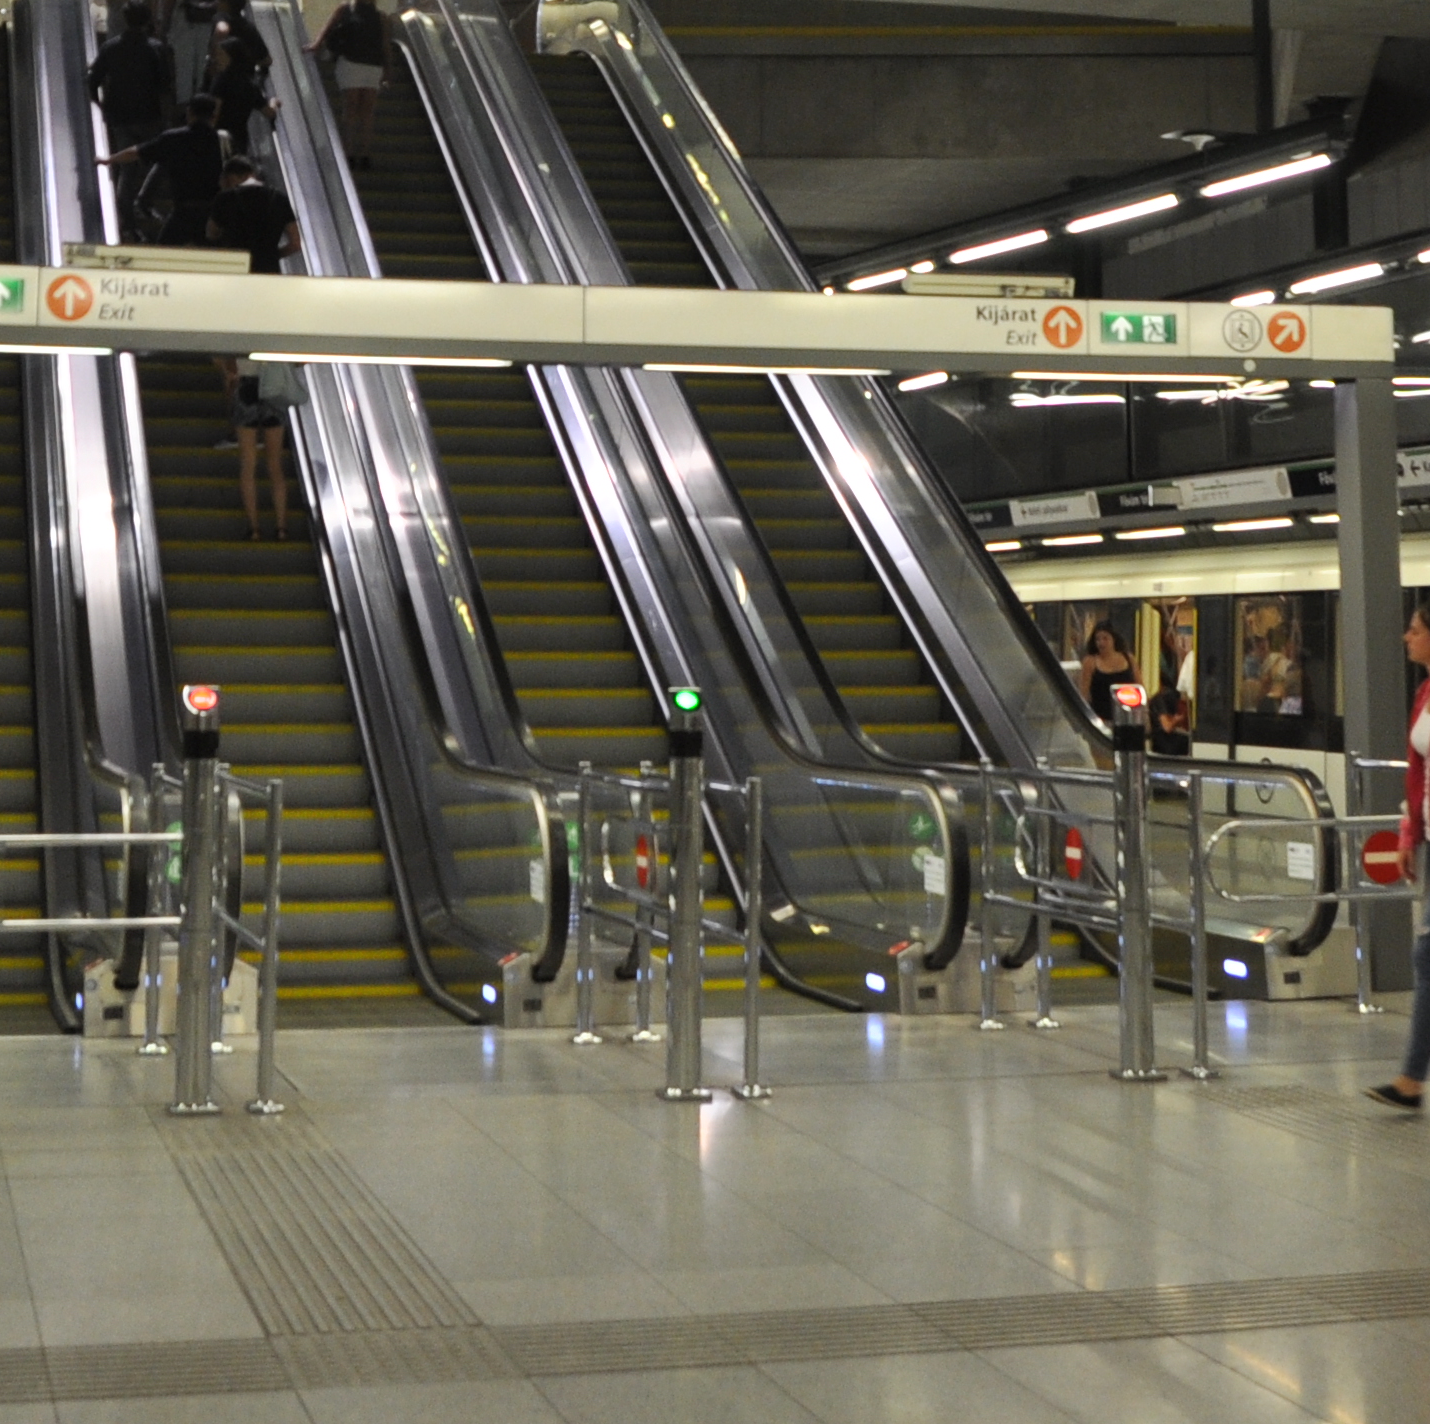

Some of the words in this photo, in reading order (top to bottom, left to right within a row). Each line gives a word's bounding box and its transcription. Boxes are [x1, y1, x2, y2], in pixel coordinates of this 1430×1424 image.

[100, 277, 170, 300] Kijárat
[97, 303, 135, 321] Exit
[976, 305, 1037, 326] Kijárat
[1005, 330, 1037, 346] Exit
